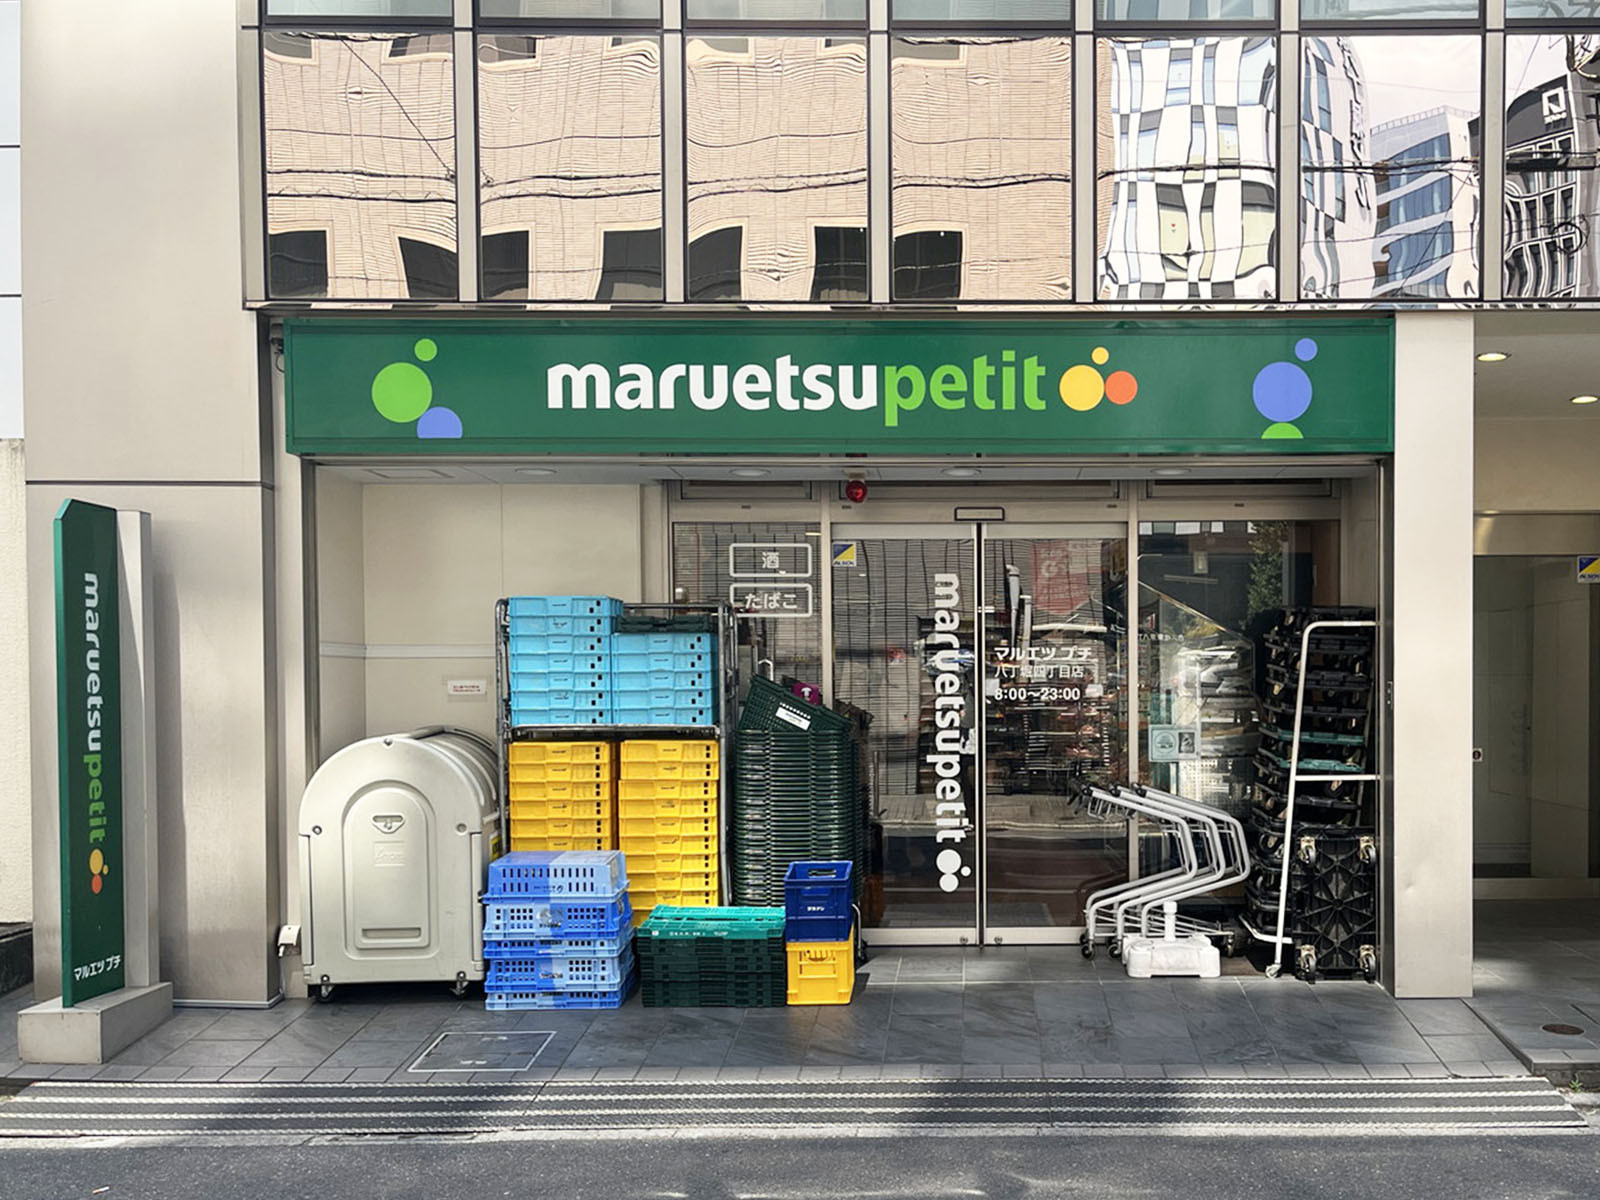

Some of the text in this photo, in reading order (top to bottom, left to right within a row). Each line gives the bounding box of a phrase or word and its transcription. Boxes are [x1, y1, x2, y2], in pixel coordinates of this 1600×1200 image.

[762, 551, 780, 569] 酒
[745, 592, 798, 609] たばこ
